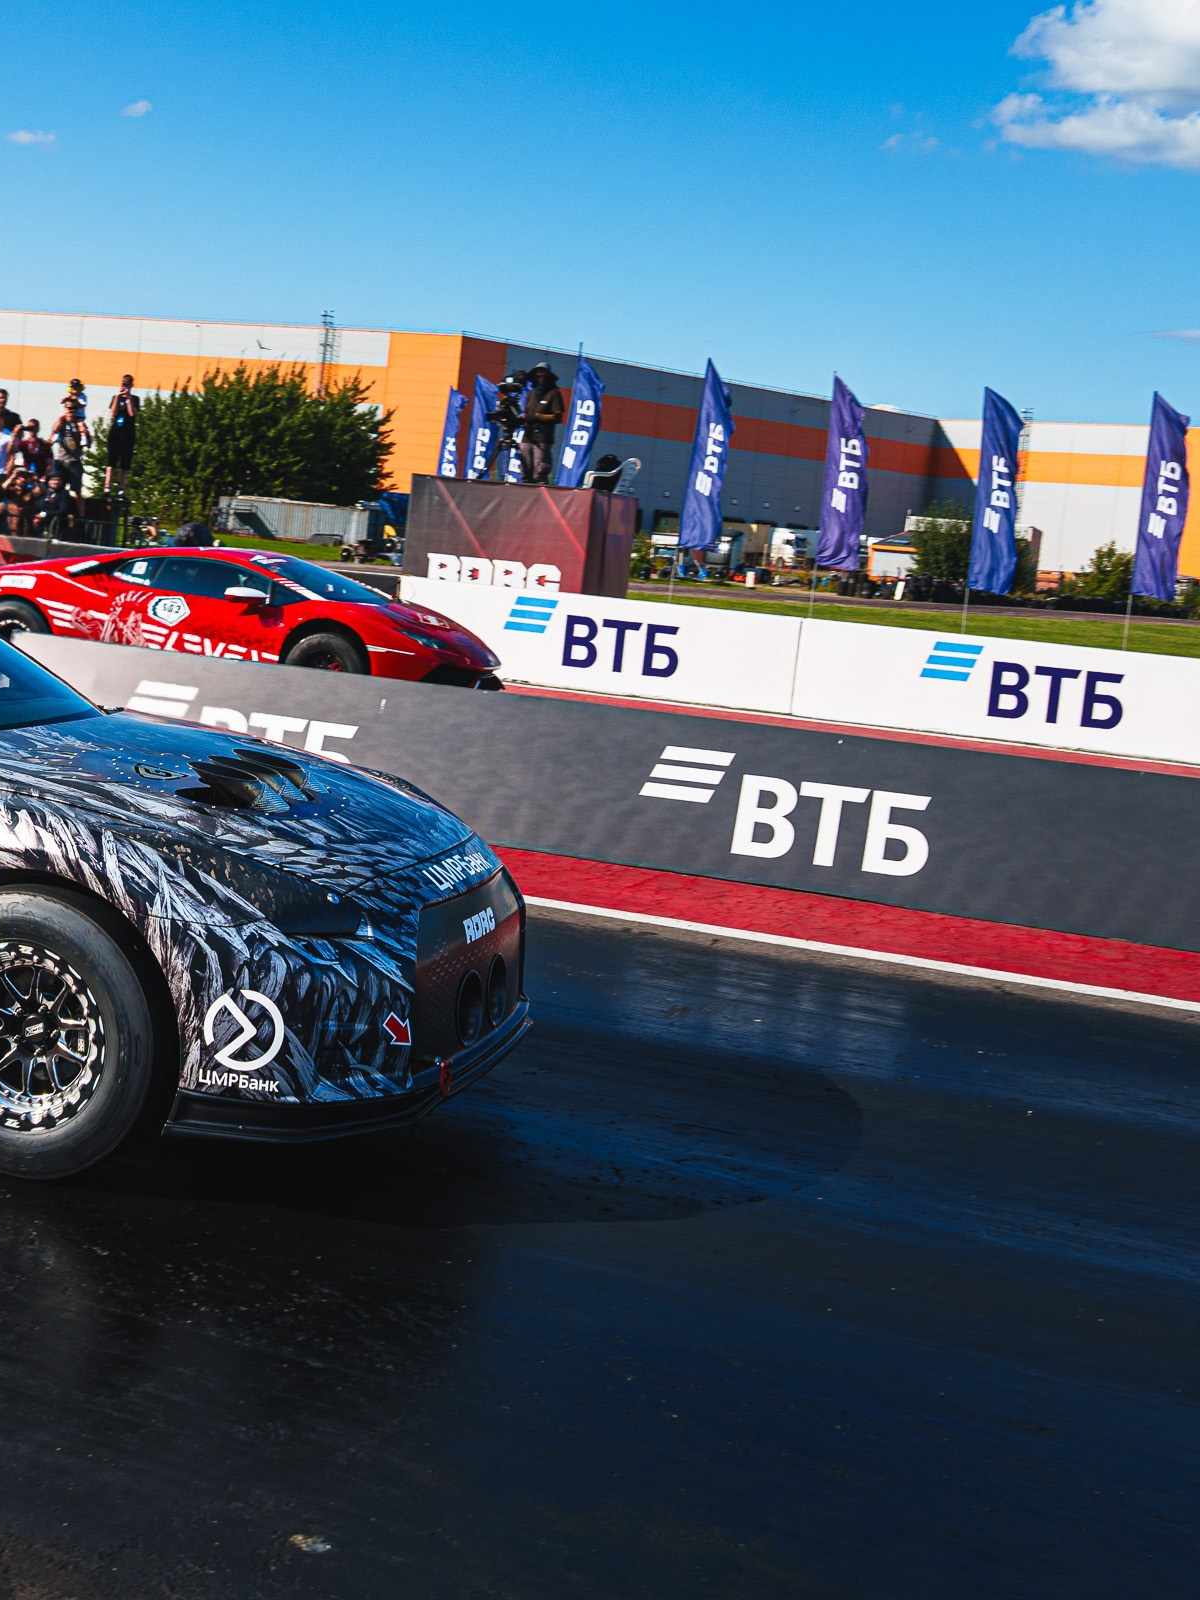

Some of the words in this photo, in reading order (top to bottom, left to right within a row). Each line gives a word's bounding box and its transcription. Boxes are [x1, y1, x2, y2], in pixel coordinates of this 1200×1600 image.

[570, 400, 595, 446] ВТБ
[838, 437, 862, 490] ВТБ
[1156, 459, 1182, 516] ВТБ
[562, 614, 680, 678] ВТБ
[987, 660, 1125, 730] ВТБ
[730, 774, 933, 877] ВТБ
[422, 852, 493, 891] ЦМРБанк
[198, 1068, 280, 1093] ЦМРБанк
